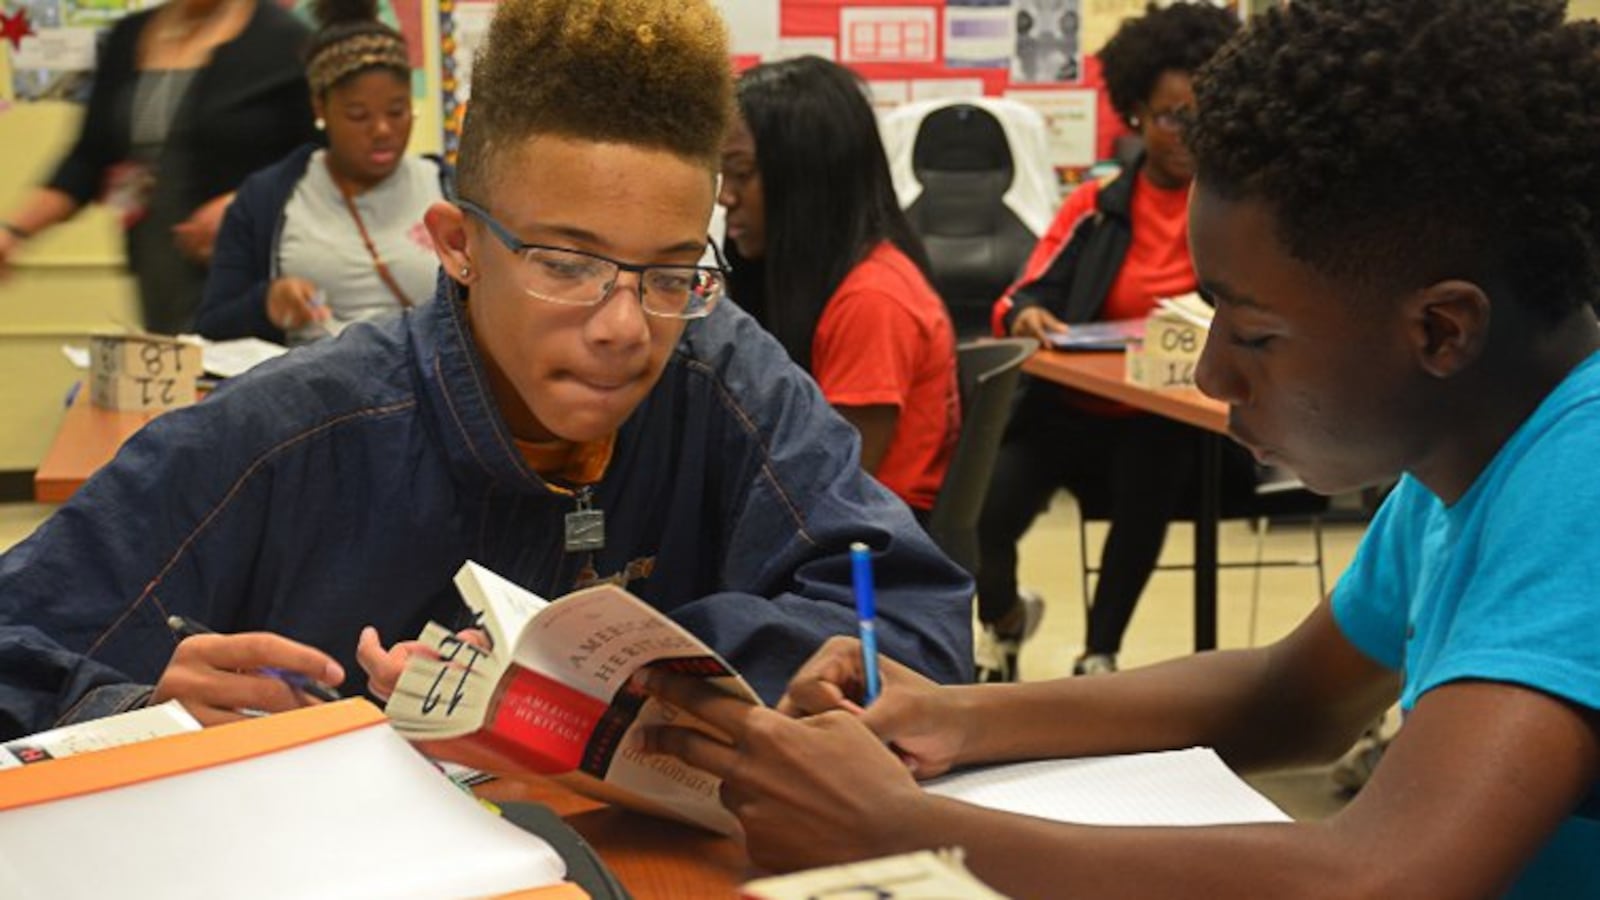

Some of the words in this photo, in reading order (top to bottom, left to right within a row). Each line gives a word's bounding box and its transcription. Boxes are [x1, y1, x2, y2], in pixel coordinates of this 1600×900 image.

[141, 340, 187, 375] 18
[1161, 327, 1197, 353] 08
[135, 378, 177, 405] 21
[594, 635, 694, 682] HERITAGE
[514, 705, 580, 742] HERITAGE
[521, 695, 590, 730] AMERICAN
